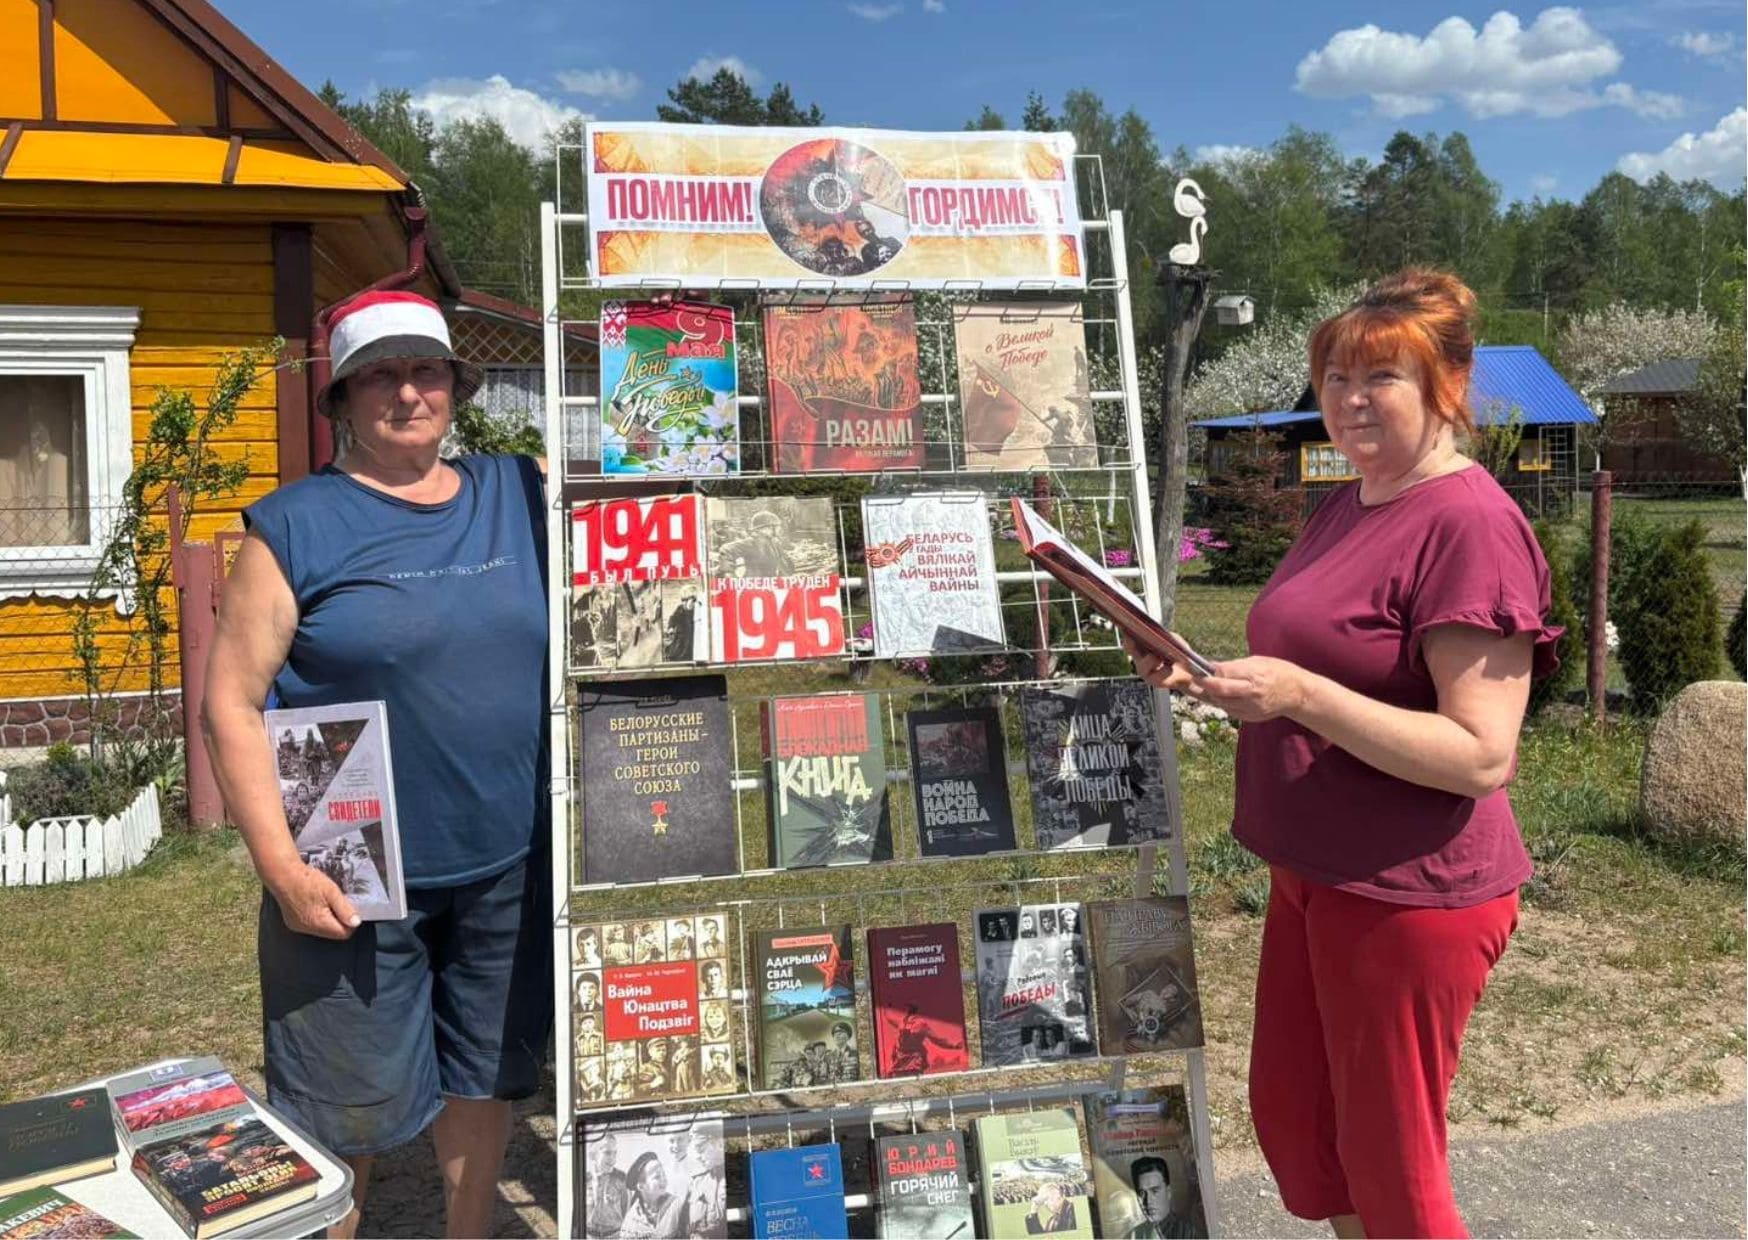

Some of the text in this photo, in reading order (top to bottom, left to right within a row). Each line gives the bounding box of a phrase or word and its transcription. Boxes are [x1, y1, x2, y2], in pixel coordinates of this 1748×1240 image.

[607, 179, 1064, 229] ПОМНИМ! ГОРДИМС!
[676, 306, 725, 345] 9
[996, 323, 1054, 349] Великой
[1001, 348, 1049, 372] Победе
[572, 496, 699, 584] 1941
[906, 532, 974, 544] БЕЛАРУСЬ
[918, 551, 976, 565] ВЯЛІКАЙ
[590, 563, 700, 585] БЫЛ ПУТЬ
[898, 565, 978, 580] АЙЧЫННАЙ
[718, 574, 831, 591] К ПОБЕДЕ ТРУДЕН
[930, 578, 980, 593] ВАЙНЫ
[711, 574, 846, 662] 1945
[609, 712, 704, 731] БЕЛОРУССКИЕ
[1070, 713, 1112, 740] ЛИЦА
[636, 747, 678, 762] ГЕРОИ
[615, 761, 700, 780] СОВЕТСКОГО
[634, 779, 682, 794] СОЮЗА
[778, 755, 873, 816] КНИГА
[921, 780, 977, 798] ВОЙНА
[1064, 775, 1132, 803] ПОБЕДЫ
[328, 799, 382, 823] СВИДЕТЕЛИ
[923, 795, 979, 812] НАРОД
[925, 807, 991, 827] ПОБЕДА
[766, 951, 828, 968] АДКРЫВАЙ
[886, 944, 943, 957] Перамогу
[607, 984, 653, 999] Вайна
[767, 979, 803, 990] СЭРЦА
[1002, 981, 1057, 1010] ПОБЕДЫ
[623, 998, 689, 1016] Юнацтва
[639, 1013, 695, 1031] Подзвіг
[888, 1156, 958, 1175] БОНДАРЕВ
[890, 1171, 960, 1195] ГОРЯЧИЙ
[927, 1189, 960, 1205] СНЕГ
